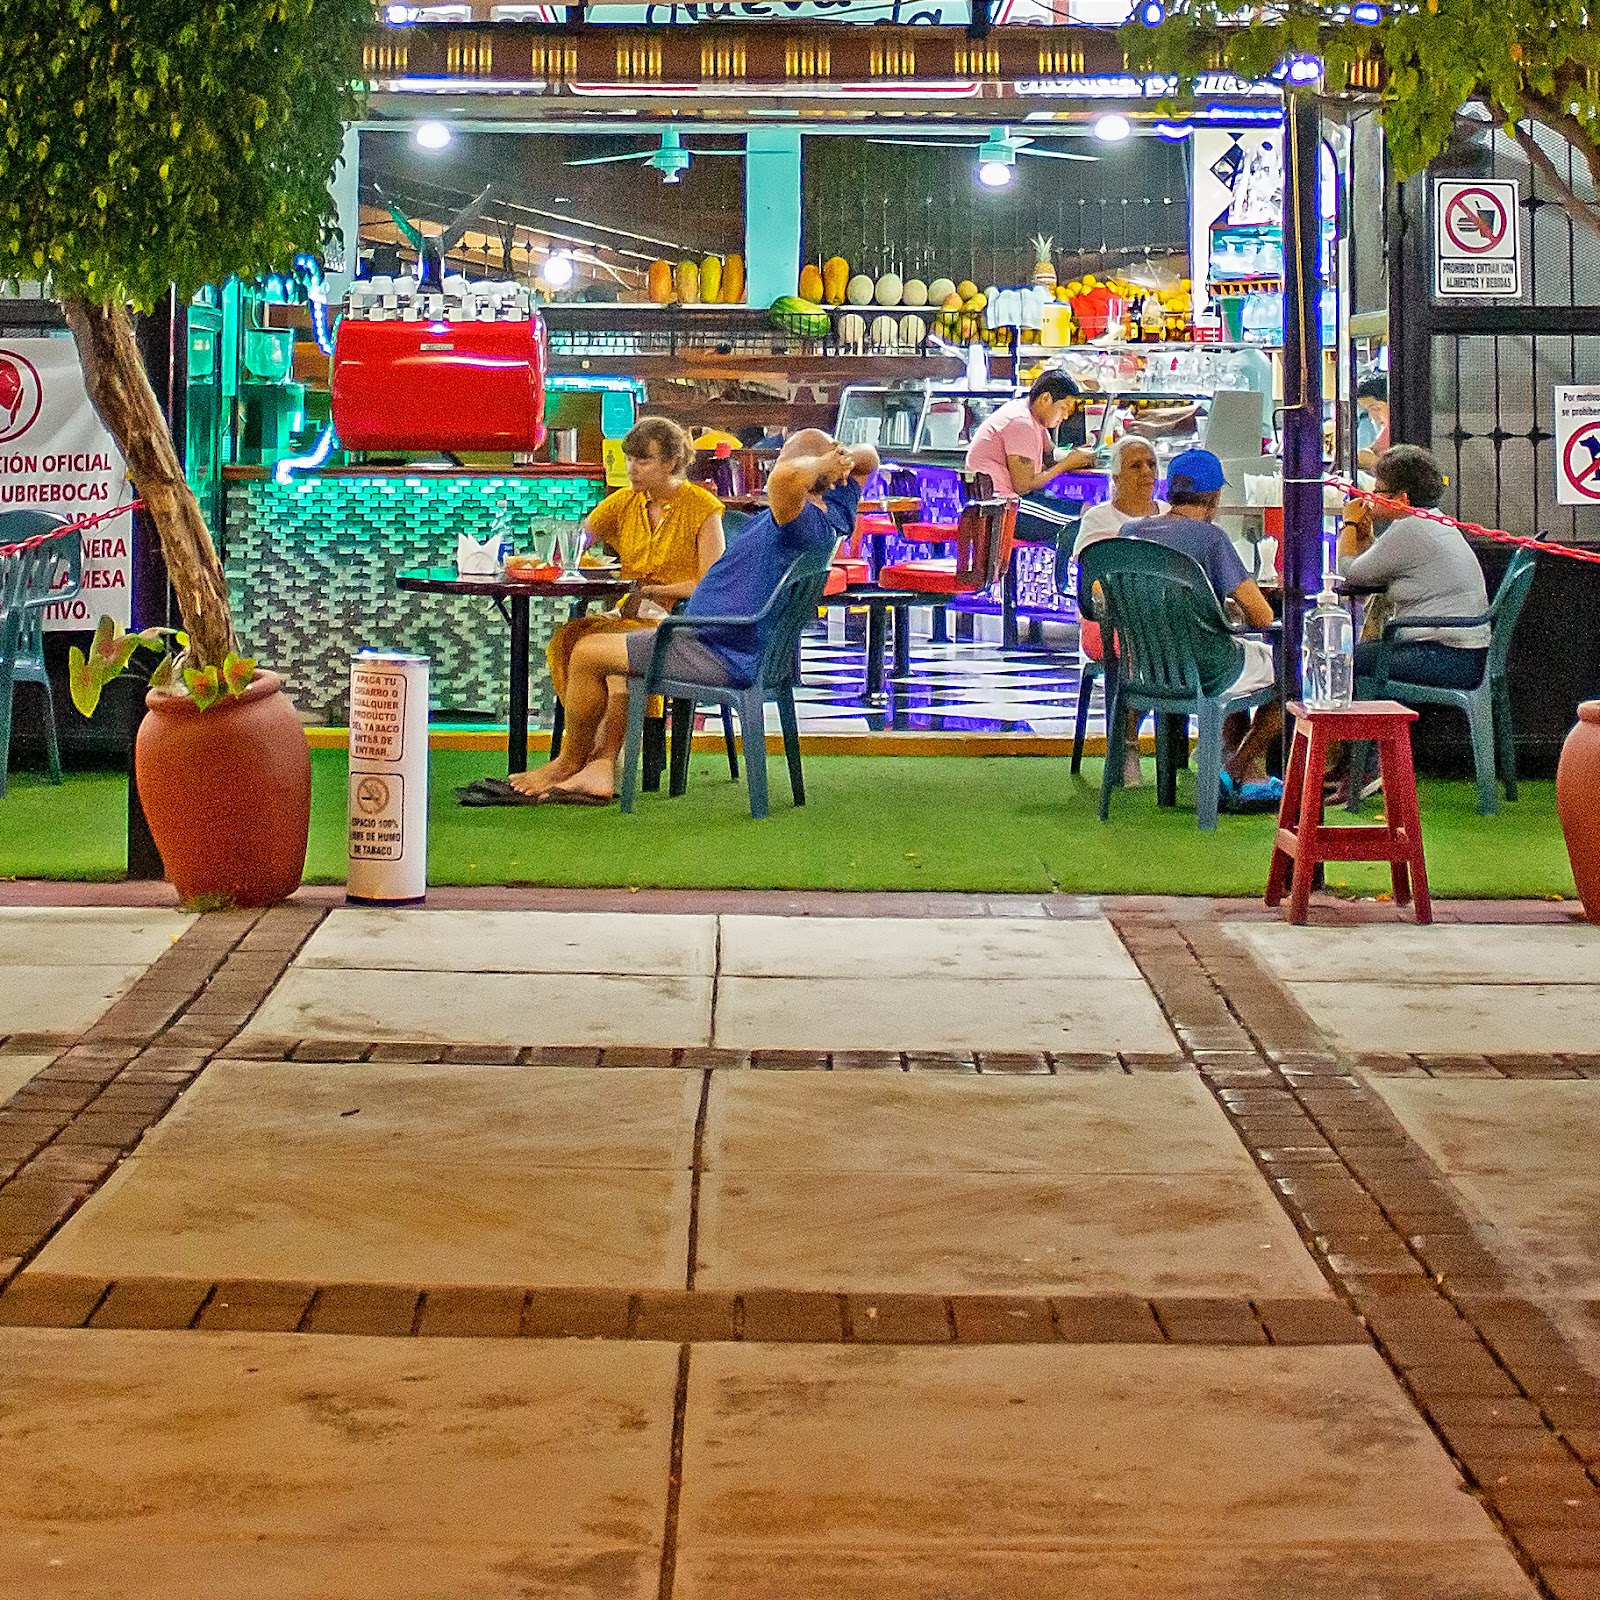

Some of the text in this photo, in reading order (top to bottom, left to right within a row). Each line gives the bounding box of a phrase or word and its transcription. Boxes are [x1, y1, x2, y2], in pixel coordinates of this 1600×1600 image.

[1563, 392, 1576, 401] Por
[42, 453, 111, 472] OFICIAL
[82, 538, 127, 558] NERA
[383, 677, 397, 686] TU
[364, 723, 400, 733] TABACO
[380, 736, 393, 745] DE
[366, 832, 375, 841] DE
[377, 832, 400, 842] HUMO
